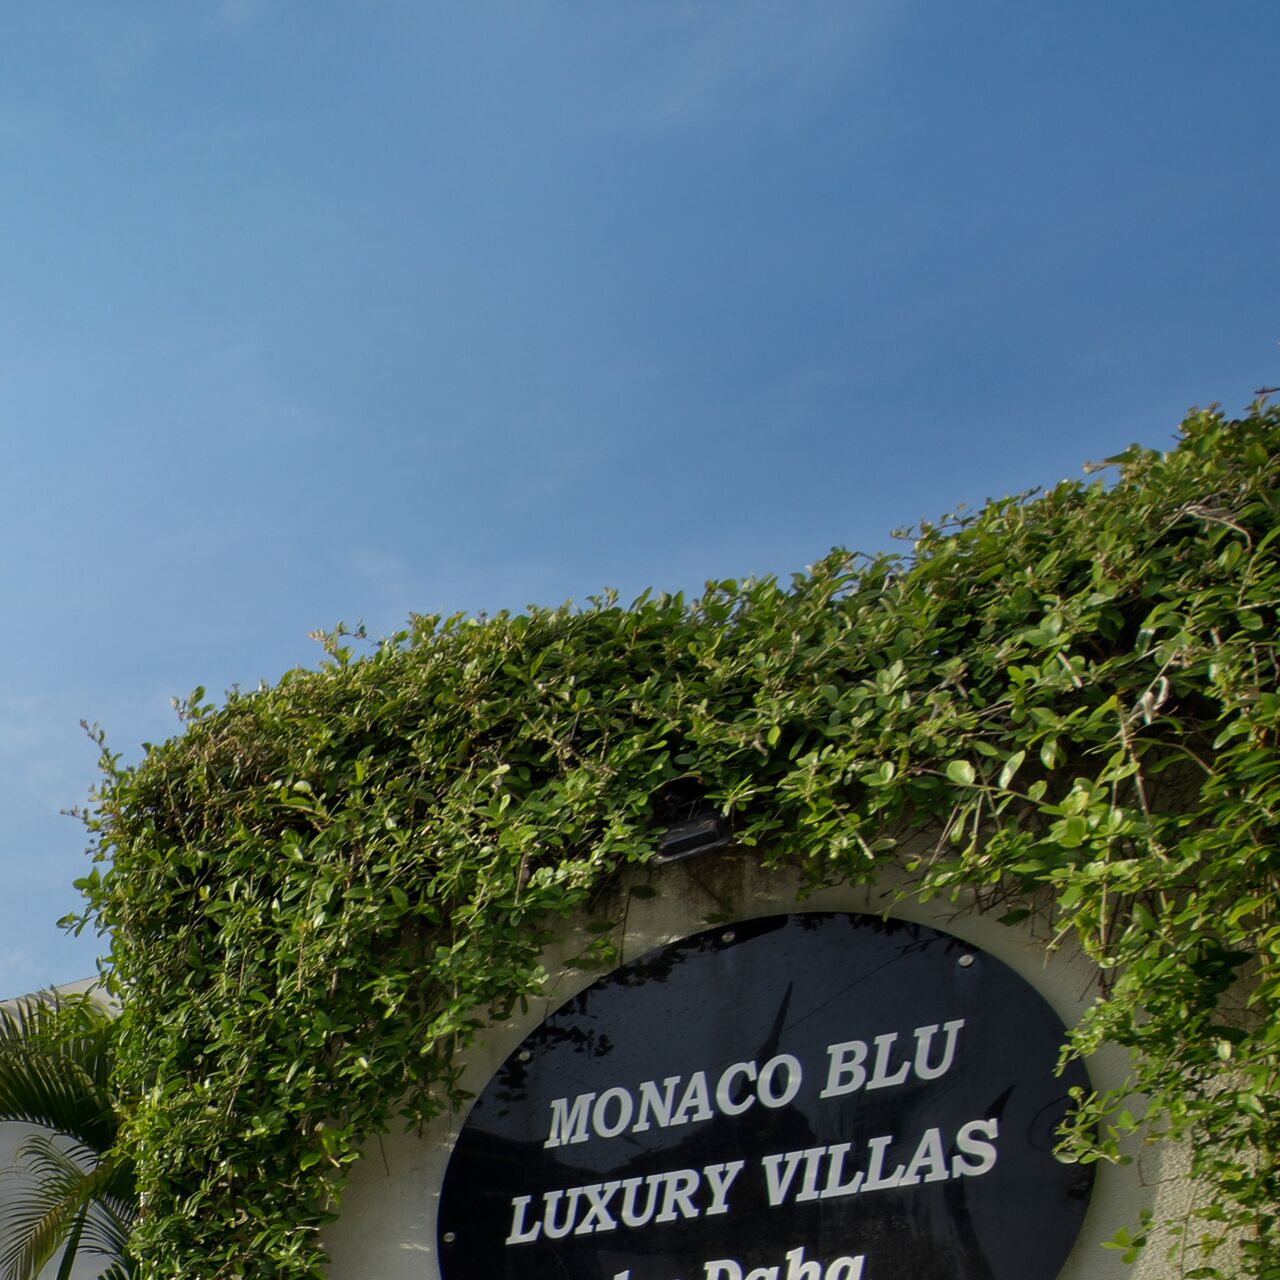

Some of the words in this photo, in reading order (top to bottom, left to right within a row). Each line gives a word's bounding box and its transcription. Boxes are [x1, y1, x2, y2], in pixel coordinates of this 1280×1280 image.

[544, 1054, 803, 1148] MONACO
[820, 1018, 965, 1099] BLU
[506, 1160, 745, 1245] LUXURY
[762, 1118, 999, 1206] VILLAS
